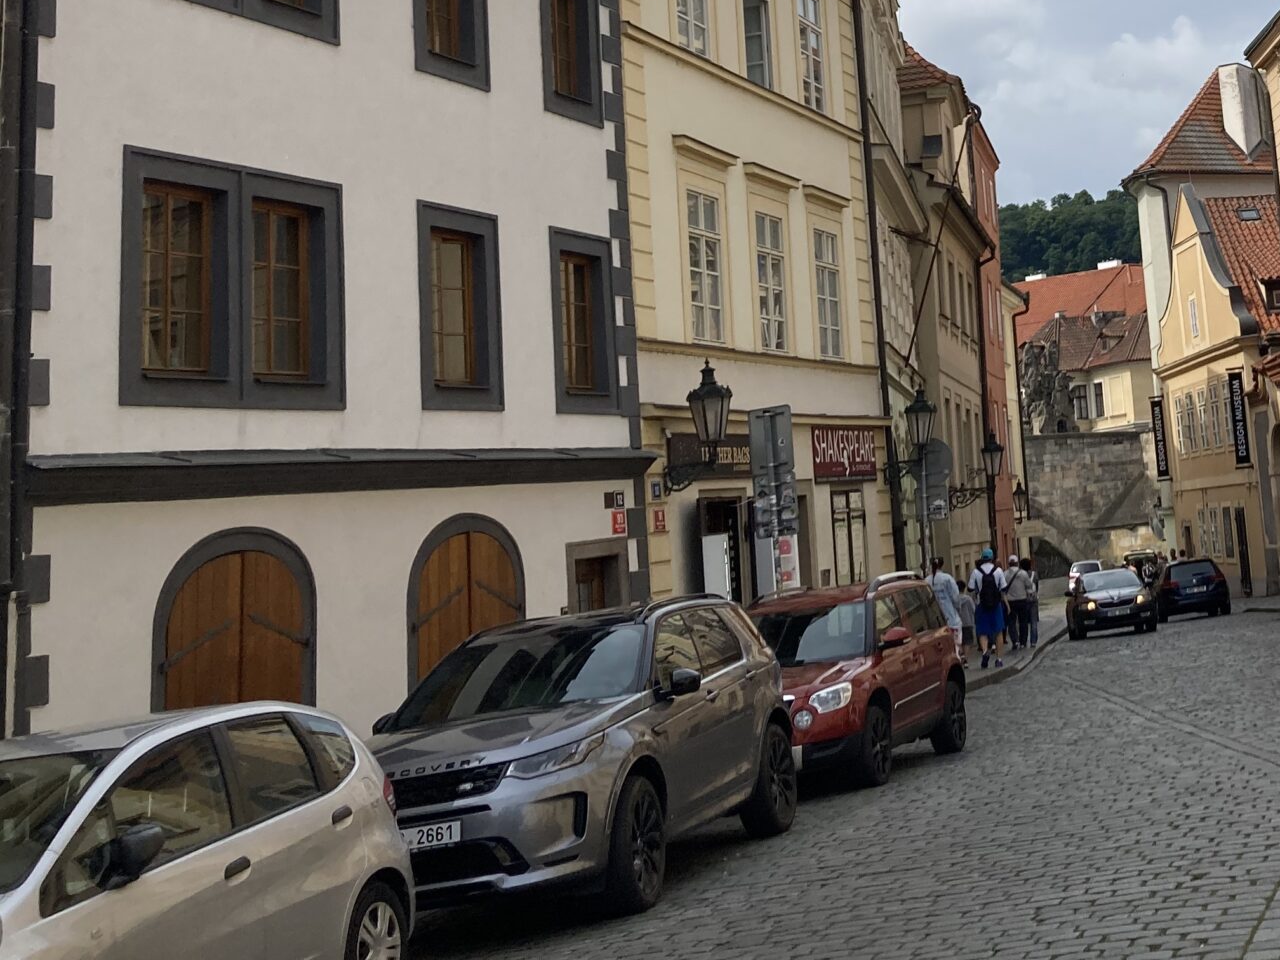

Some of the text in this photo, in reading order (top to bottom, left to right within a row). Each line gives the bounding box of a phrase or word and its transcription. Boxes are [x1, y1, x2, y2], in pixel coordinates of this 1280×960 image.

[1232, 379, 1247, 456] DESIGN MUSEUM
[733, 446, 751, 464] BAGS
[814, 429, 876, 463] SHAKESPEARE
[1153, 406, 1167, 471] DESIGN MUSEUM
[416, 824, 454, 845] 2661
